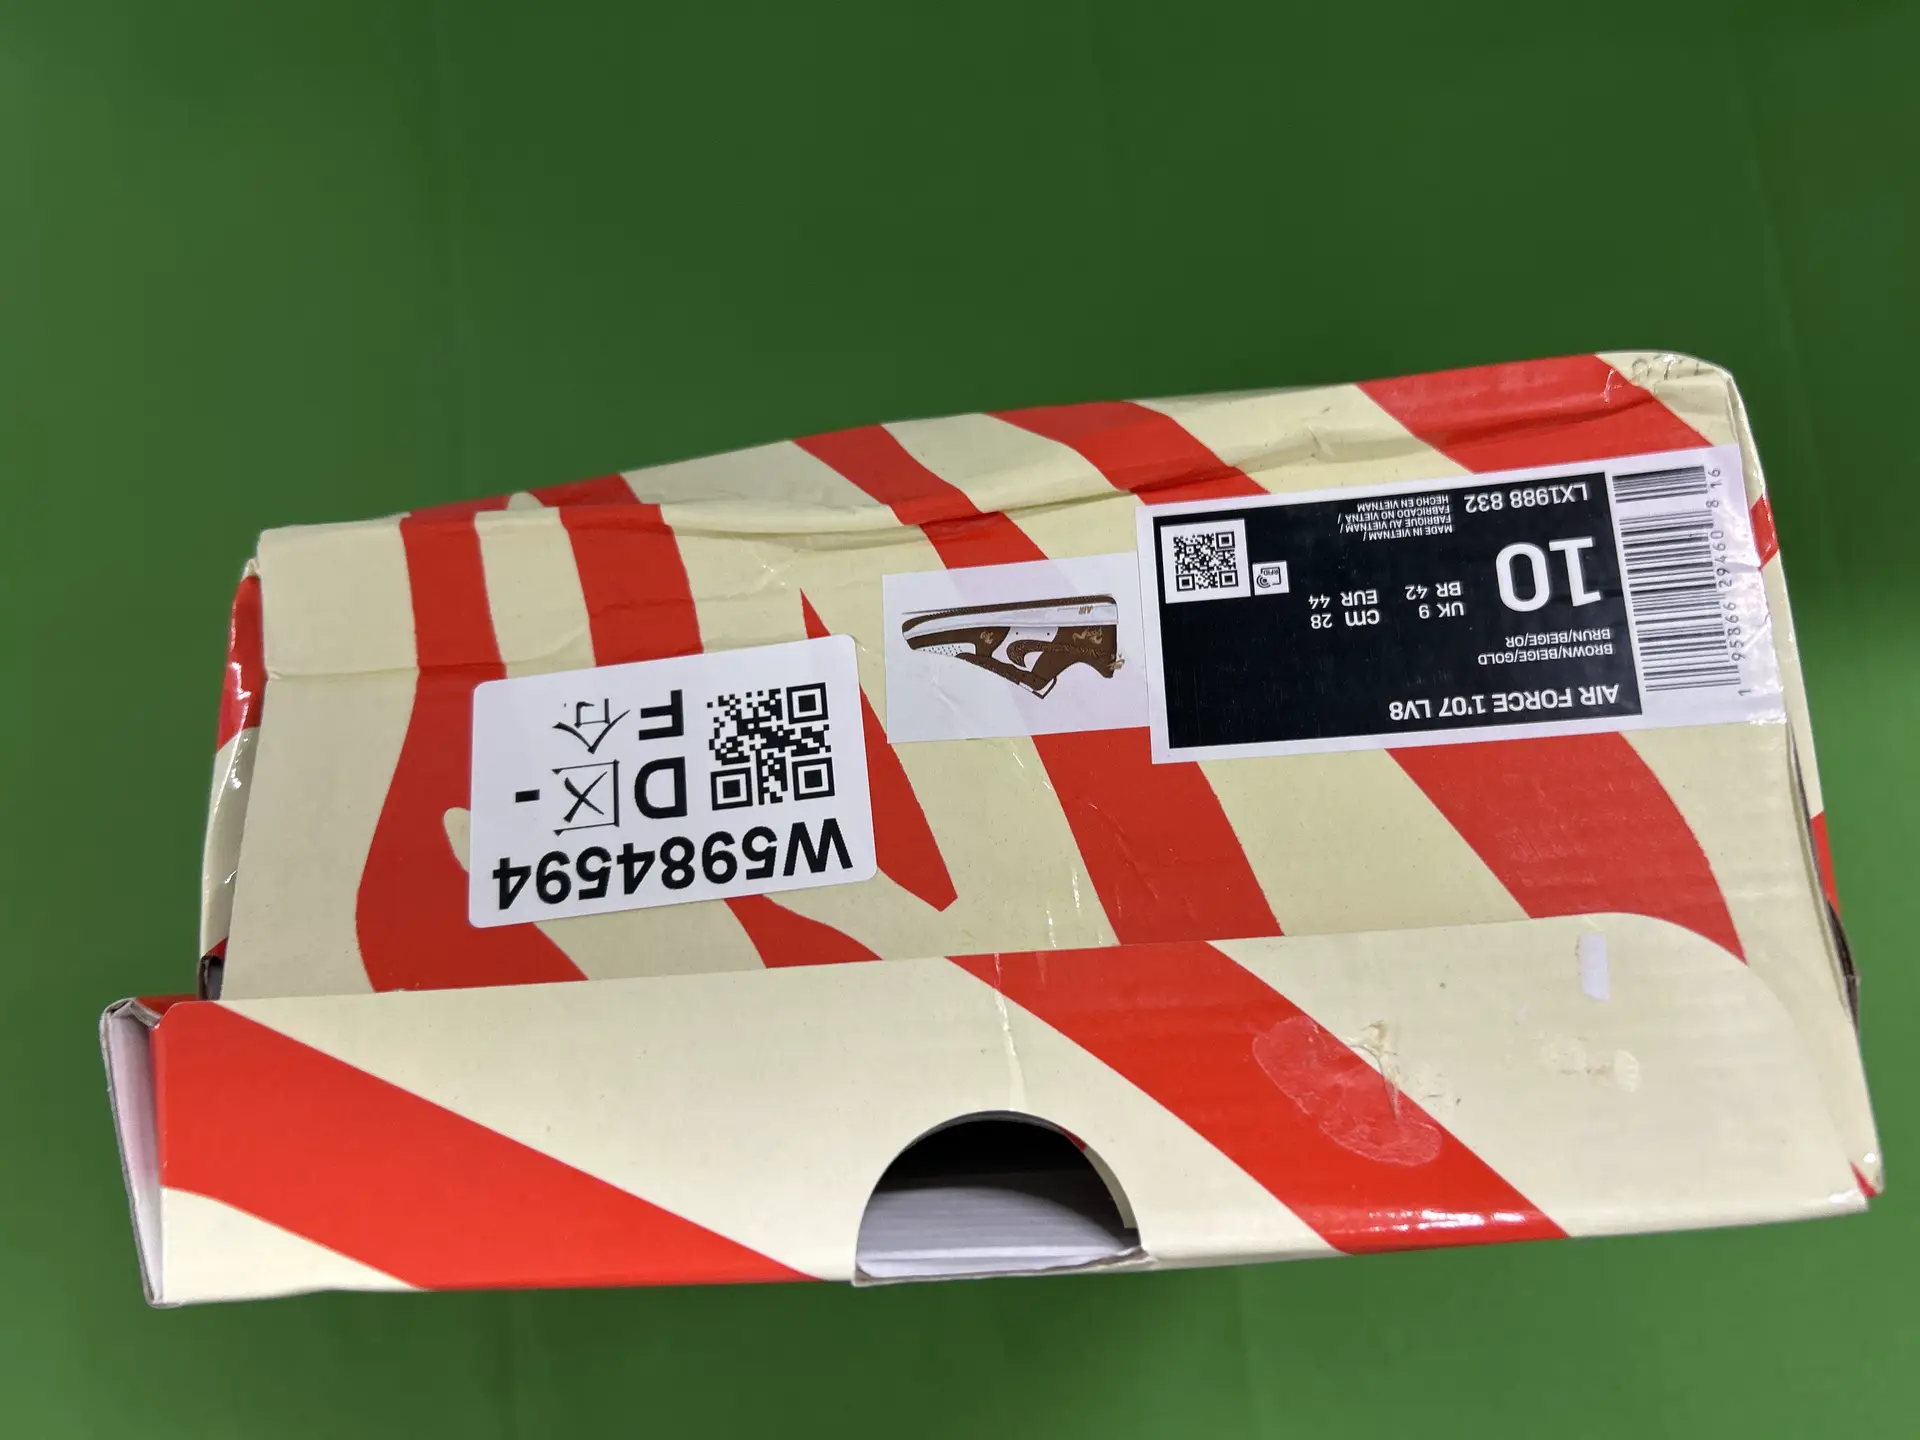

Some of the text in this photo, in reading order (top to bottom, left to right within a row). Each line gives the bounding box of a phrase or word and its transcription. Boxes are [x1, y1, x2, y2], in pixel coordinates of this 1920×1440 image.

[1707, 467, 1722, 489] 16
[1356, 493, 1449, 513] HECHO EN VIETNAM
[1463, 481, 1588, 513] LX1988 832
[1380, 509, 1395, 520] NO
[1396, 504, 1450, 519] FABRICADO
[1404, 514, 1452, 528] FABRIQUE
[1345, 520, 1388, 534] VIETNAM
[1389, 519, 1403, 529] AU
[1412, 527, 1423, 537] IN
[1424, 523, 1453, 536] MADE
[1368, 528, 1411, 541] VIETNAM
[1709, 530, 1733, 589] 29460
[1495, 536, 1601, 613] 10
[1308, 589, 1378, 610] EUR 44
[1404, 580, 1462, 601] BR 42
[1310, 609, 1380, 629] cm 28
[1418, 601, 1465, 620] UK 9
[1505, 628, 1611, 648] BRUN/BEIGE/OR
[1723, 601, 1747, 662] 95866
[1477, 643, 1613, 666] BROWN/BEIGE/GOLD
[1388, 684, 1619, 721] AIR FORCE 1'07 LV8
[492, 818, 853, 910] W5984594
